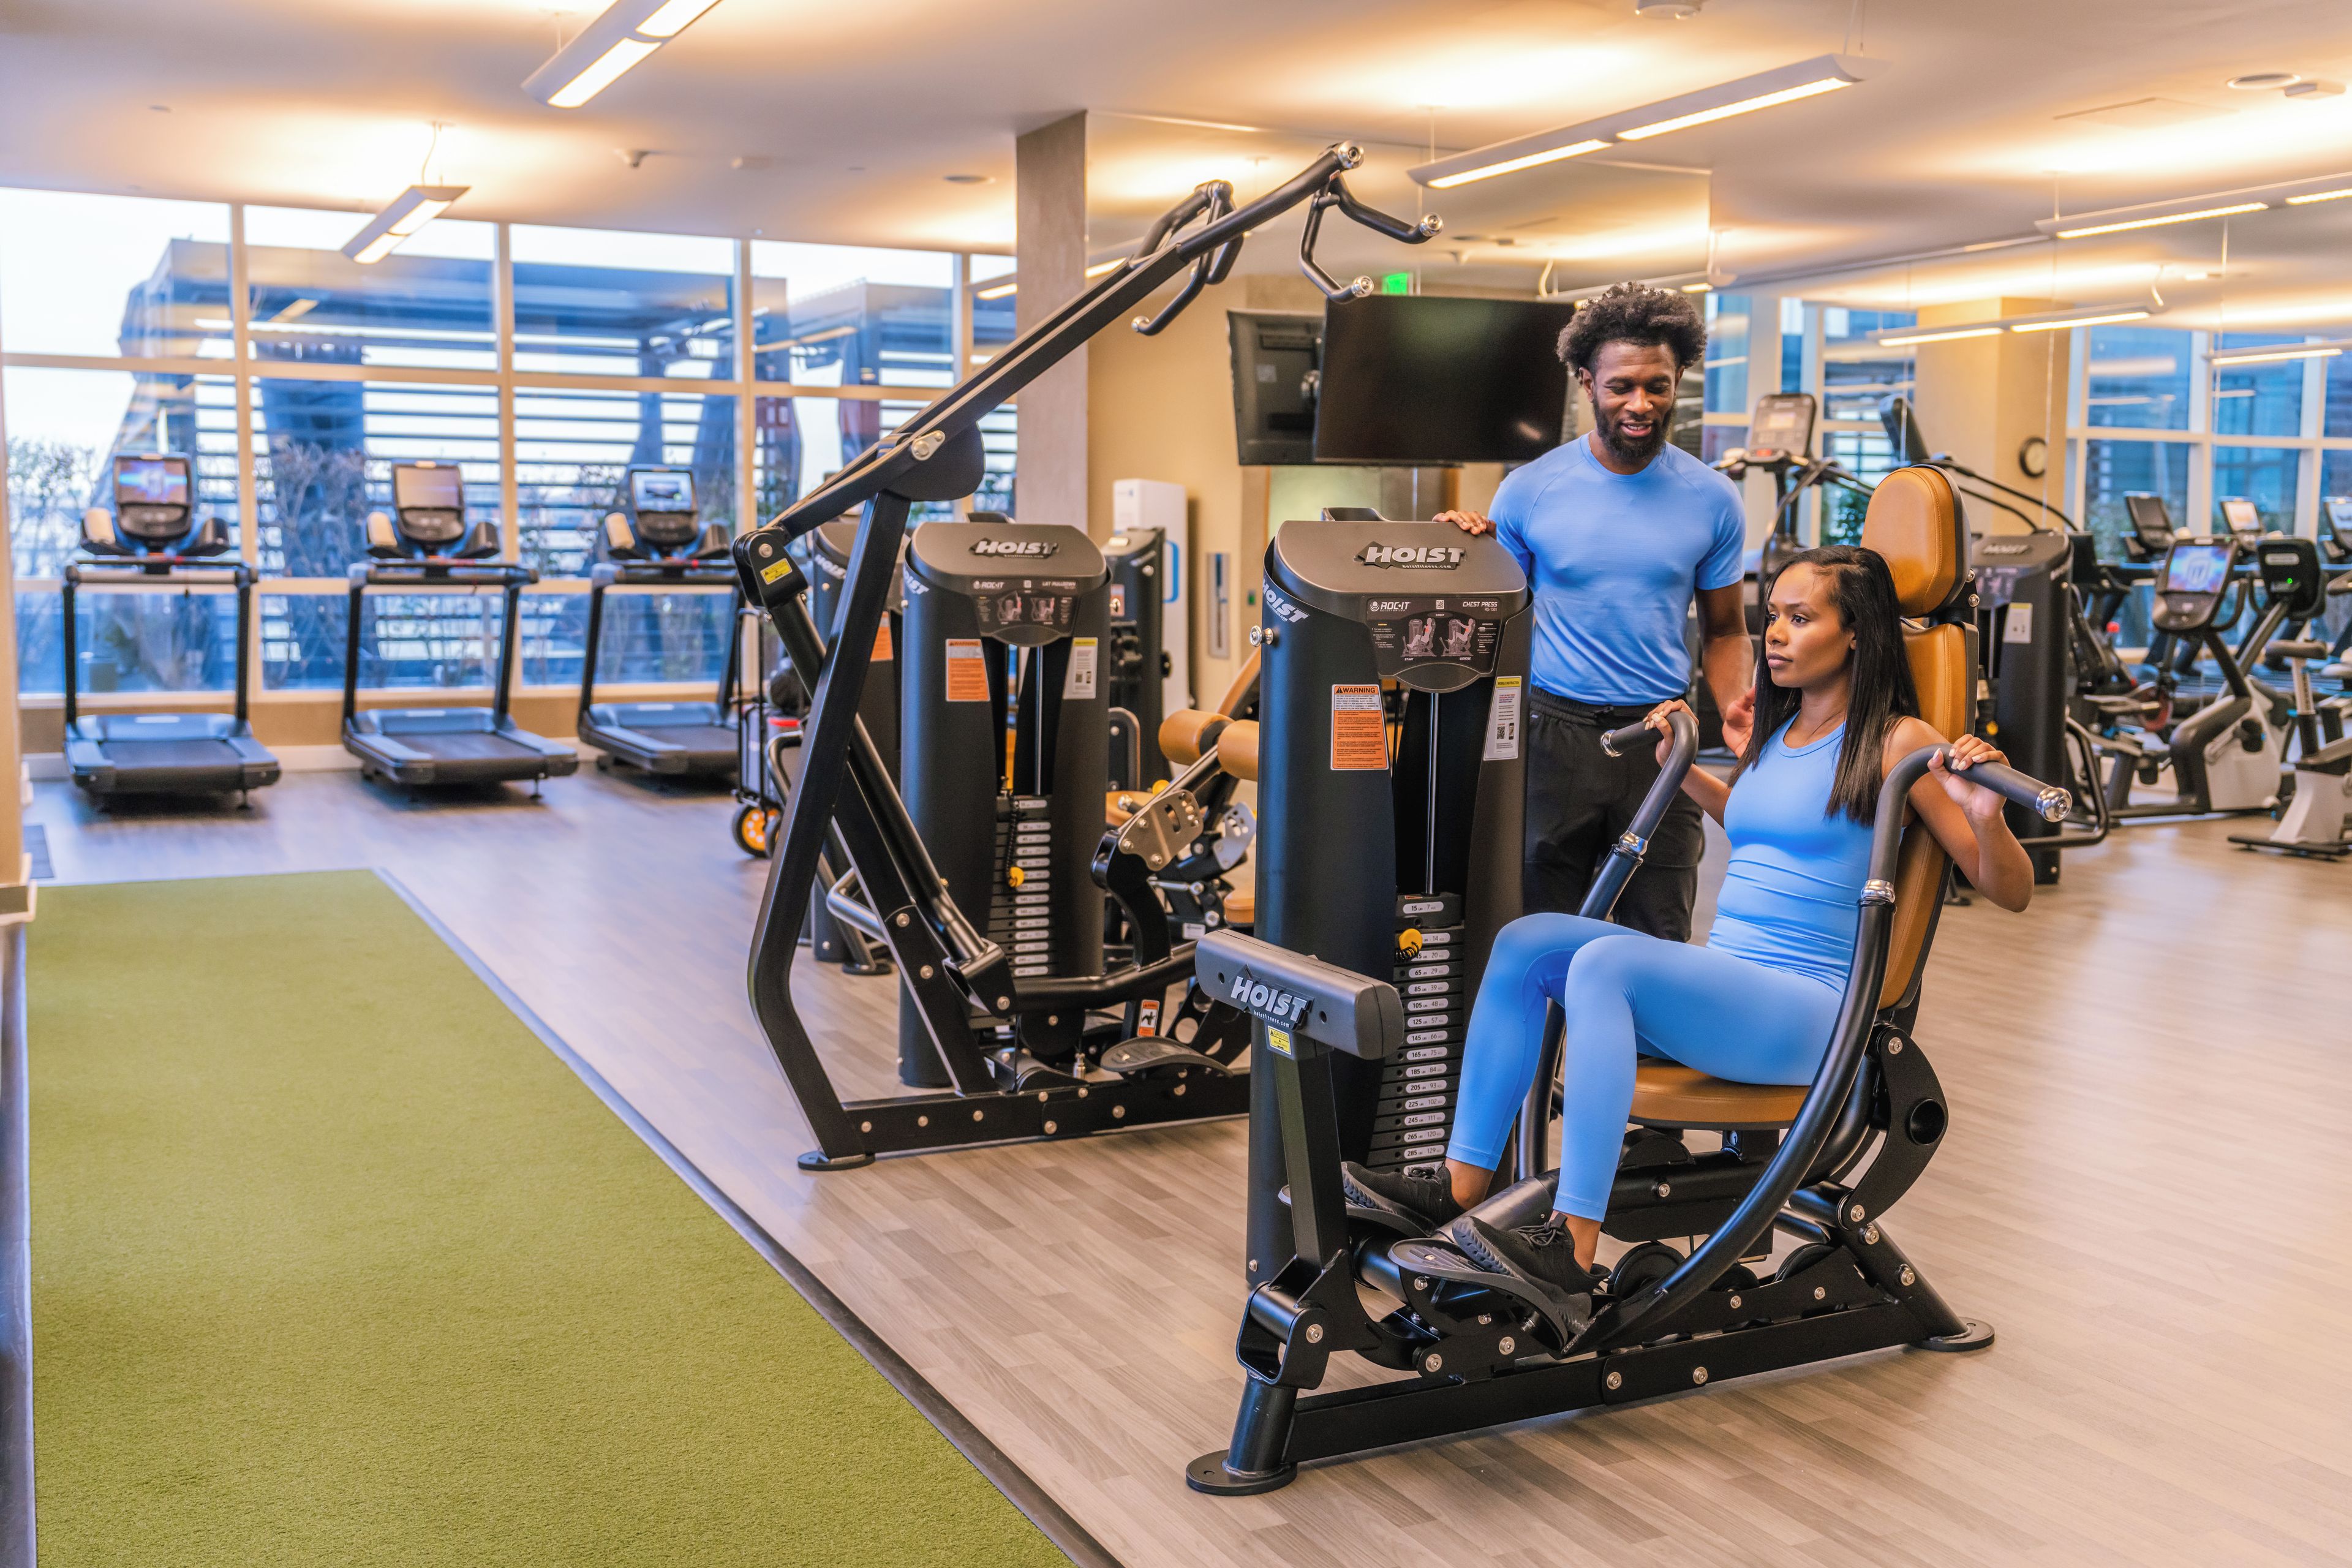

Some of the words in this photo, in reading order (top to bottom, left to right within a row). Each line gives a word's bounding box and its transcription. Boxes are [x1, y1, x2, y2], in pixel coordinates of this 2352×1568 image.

[975, 541, 1057, 554] HOIST
[1366, 546, 1465, 563] HOIST
[1262, 578, 1309, 623] HOIST
[1231, 976, 1308, 1022] HOIST
[1253, 1009, 1290, 1028] hoistfitness.com
[1273, 1030, 1289, 1041] CAUTION
